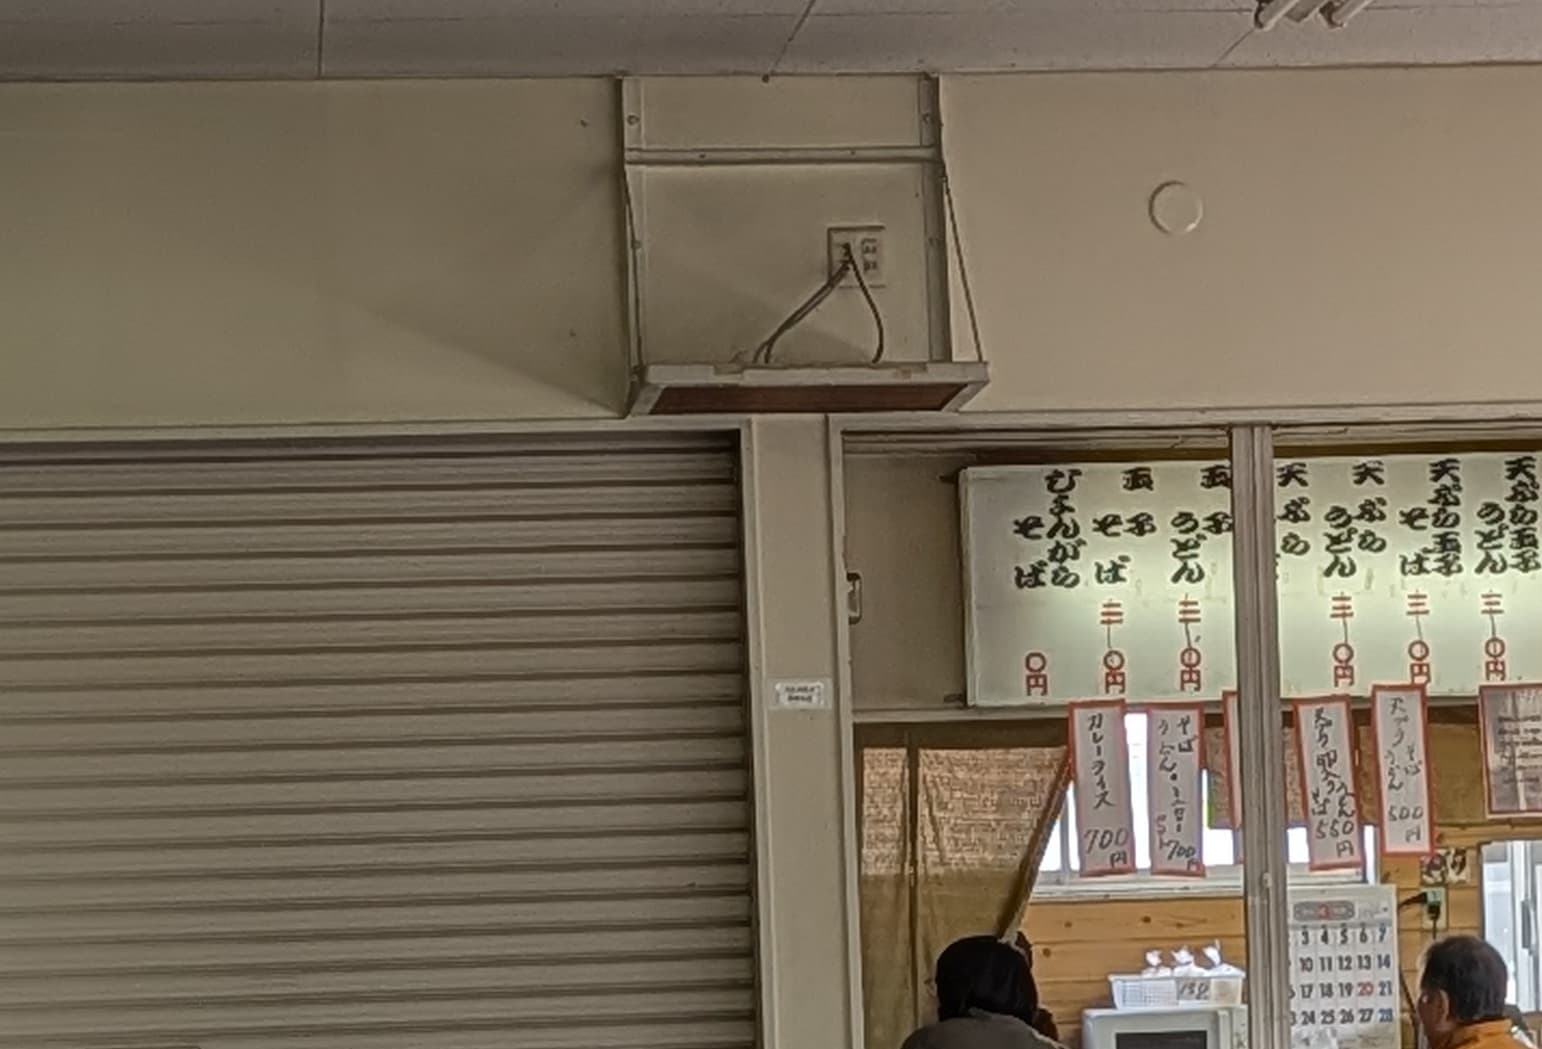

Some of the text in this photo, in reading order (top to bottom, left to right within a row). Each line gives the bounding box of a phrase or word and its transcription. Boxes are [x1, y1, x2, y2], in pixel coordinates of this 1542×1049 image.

[1302, 926, 1386, 944] 3 4 5 6 7
[1299, 954, 1391, 972] 10 11 12 13 14
[1300, 984, 1313, 998] 17
[1319, 983, 1334, 997] 18
[1338, 982, 1353, 997] 19
[1357, 981, 1373, 996] 20
[1378, 980, 1392, 996] 21
[1301, 1010, 1315, 1025] 24
[1321, 1009, 1335, 1024] 25
[1340, 1008, 1354, 1024] 26
[1358, 1008, 1373, 1022] 27
[1378, 1008, 1393, 1022] 28
